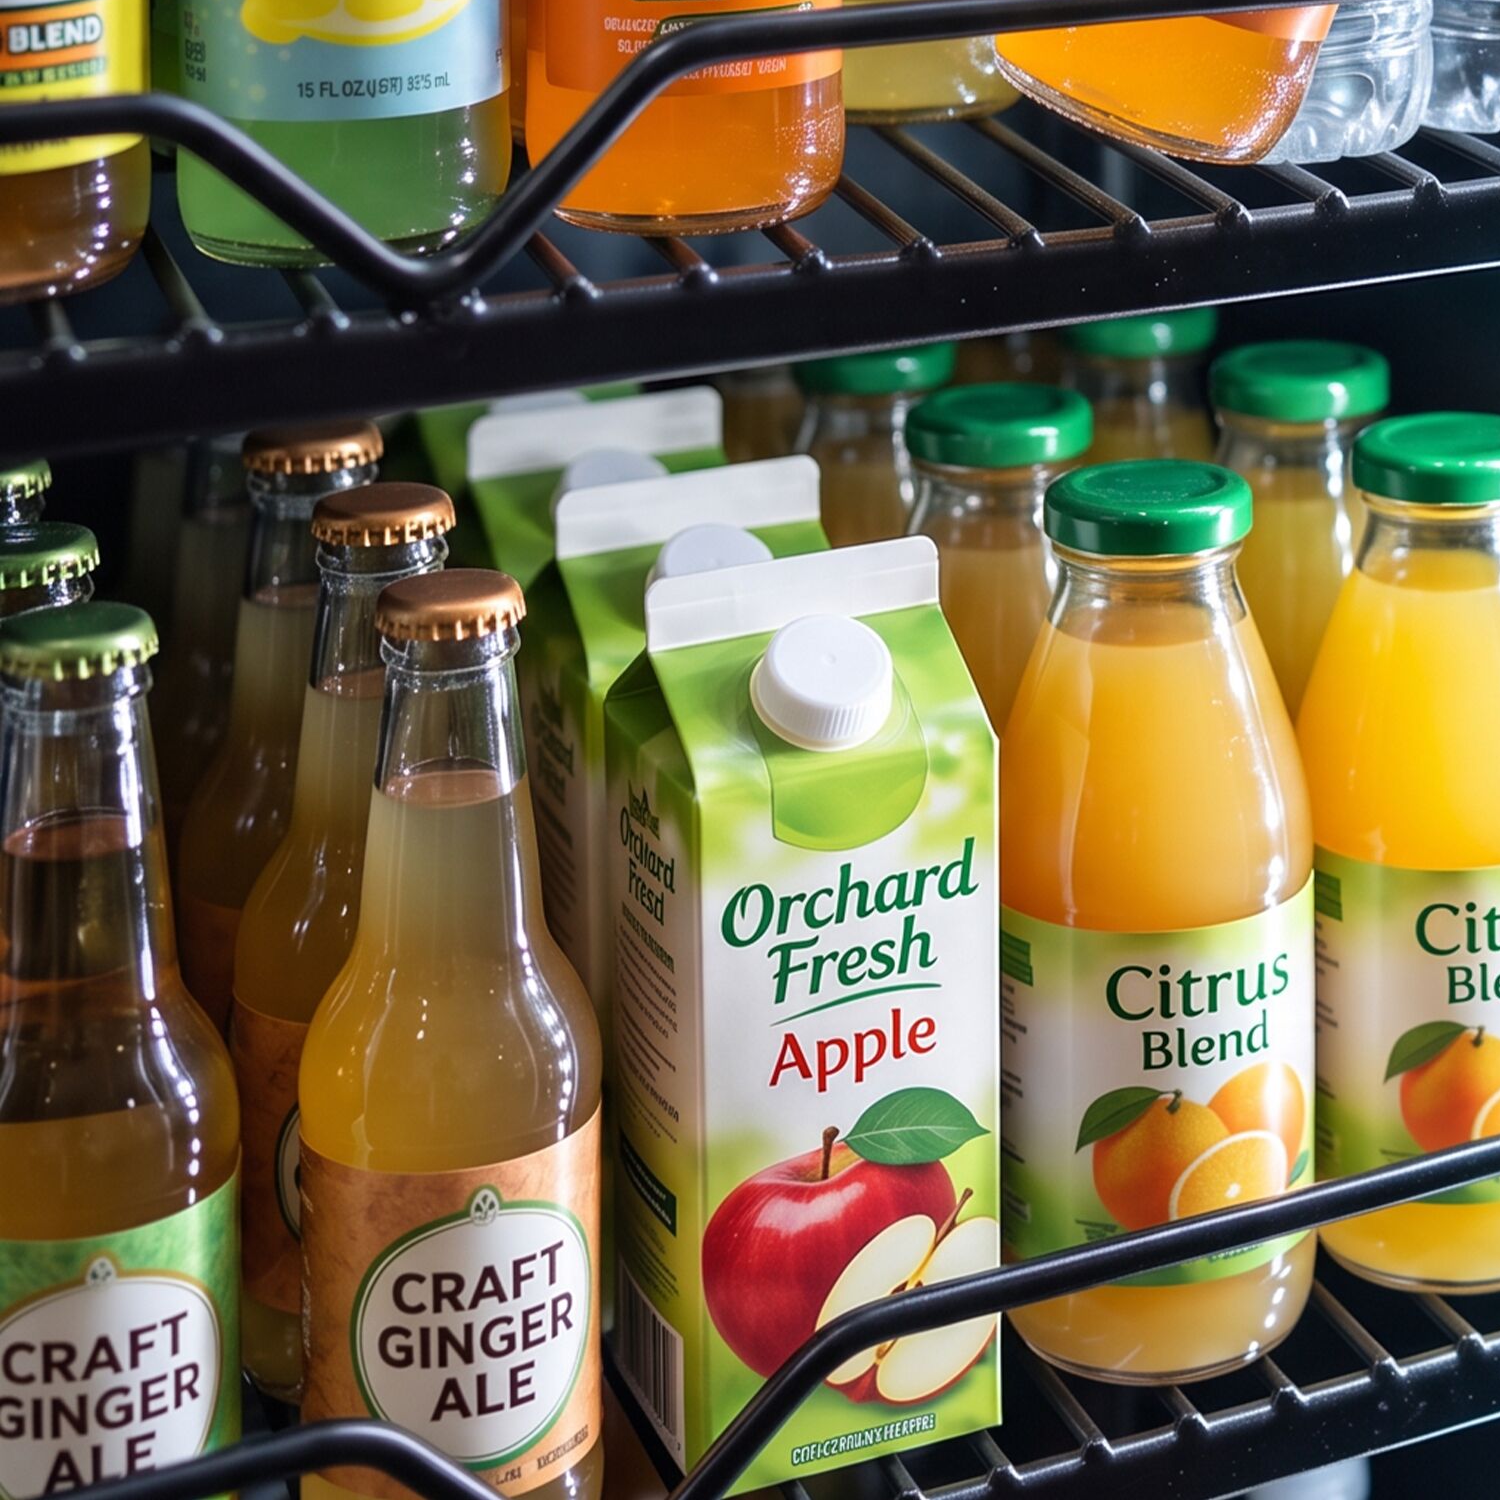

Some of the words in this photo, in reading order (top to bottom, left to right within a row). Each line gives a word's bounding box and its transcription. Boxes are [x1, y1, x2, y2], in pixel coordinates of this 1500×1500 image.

[8, 16, 102, 53] BLEND
[720, 837, 979, 947] Orchard
[767, 915, 938, 1005] Fresh
[1105, 951, 1290, 1023] Citrus
[769, 1007, 937, 1093] Apple
[1142, 1009, 1270, 1071] Blend
[391, 1240, 565, 1316] CRAFT
[2, 1310, 188, 1385] CRAFT
[377, 1292, 574, 1370] GINGER
[0, 1362, 200, 1440] GINGER
[431, 1361, 538, 1422] ALE
